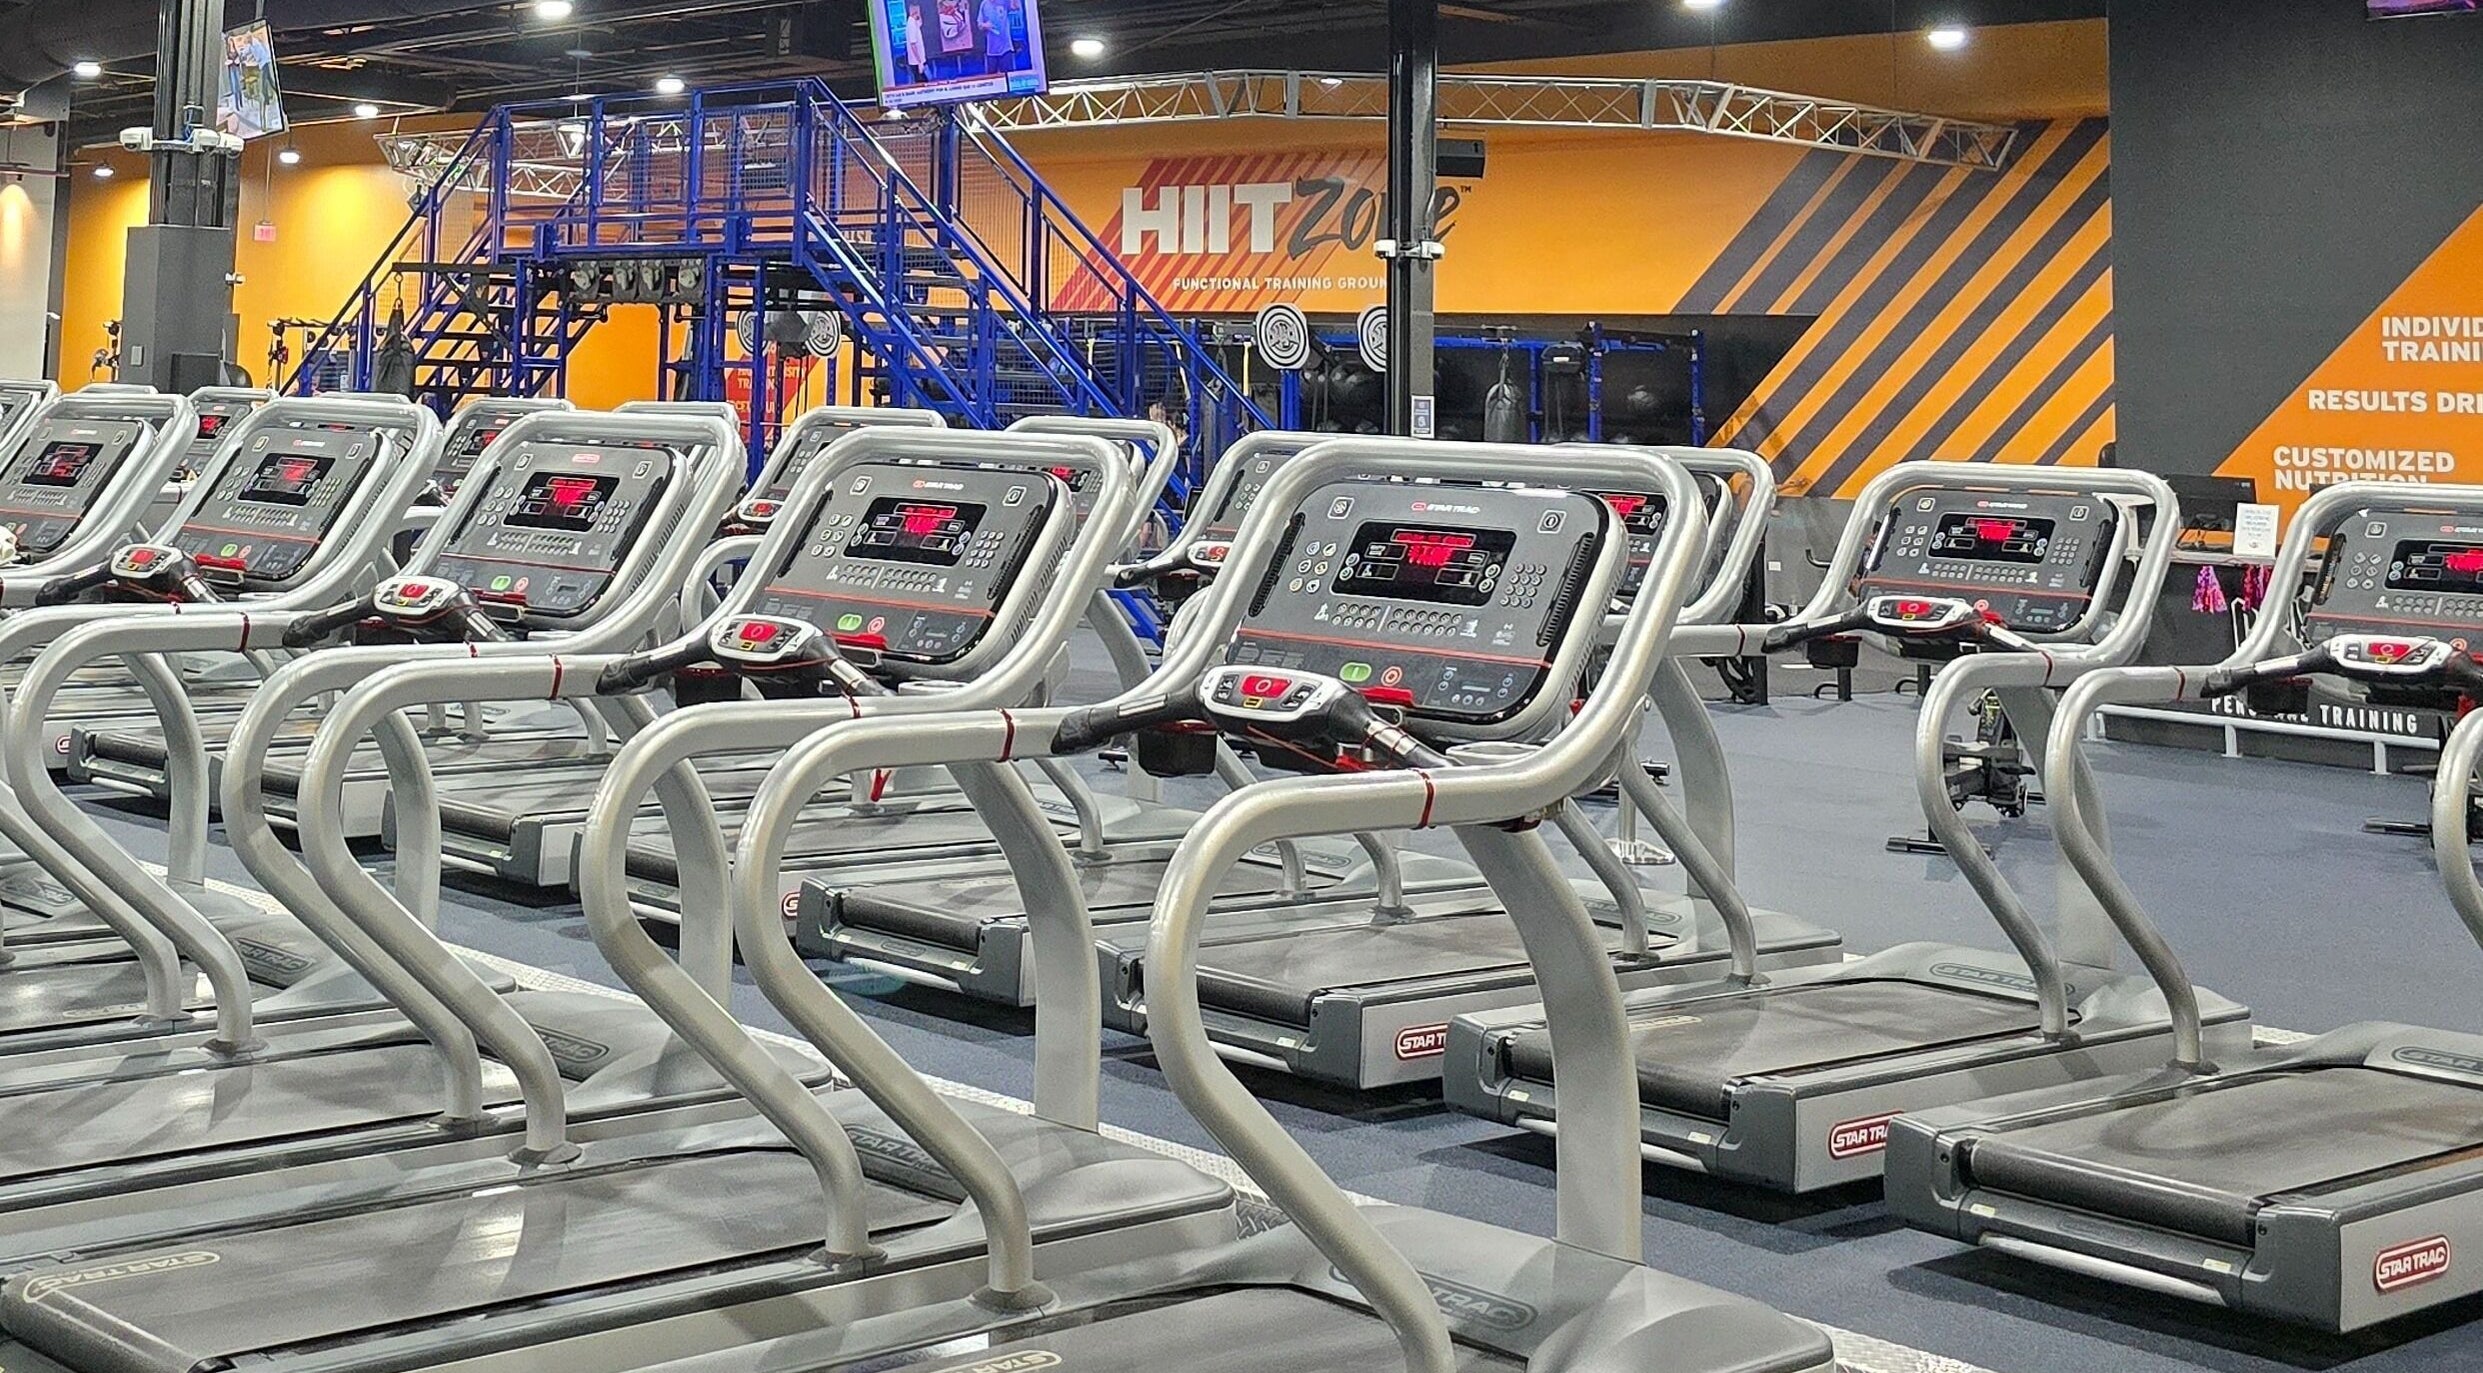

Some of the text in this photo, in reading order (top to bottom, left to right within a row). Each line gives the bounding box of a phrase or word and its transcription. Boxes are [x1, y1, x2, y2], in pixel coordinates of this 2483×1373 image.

[1121, 182, 1293, 254] HIIT
[1287, 177, 1461, 261] Zoe
[1173, 277, 1260, 290] FUNCTIONAL
[1264, 276, 1333, 290] TRAINING
[2308, 389, 2428, 413] RESULTS
[2273, 446, 2455, 473] CUSTOMIZED
[2319, 704, 2417, 734] TRAINING
[1400, 1034, 1436, 1050] STAR
[1833, 1129, 1868, 1149] STAR
[2379, 1246, 2446, 1280] STAR TRAC
